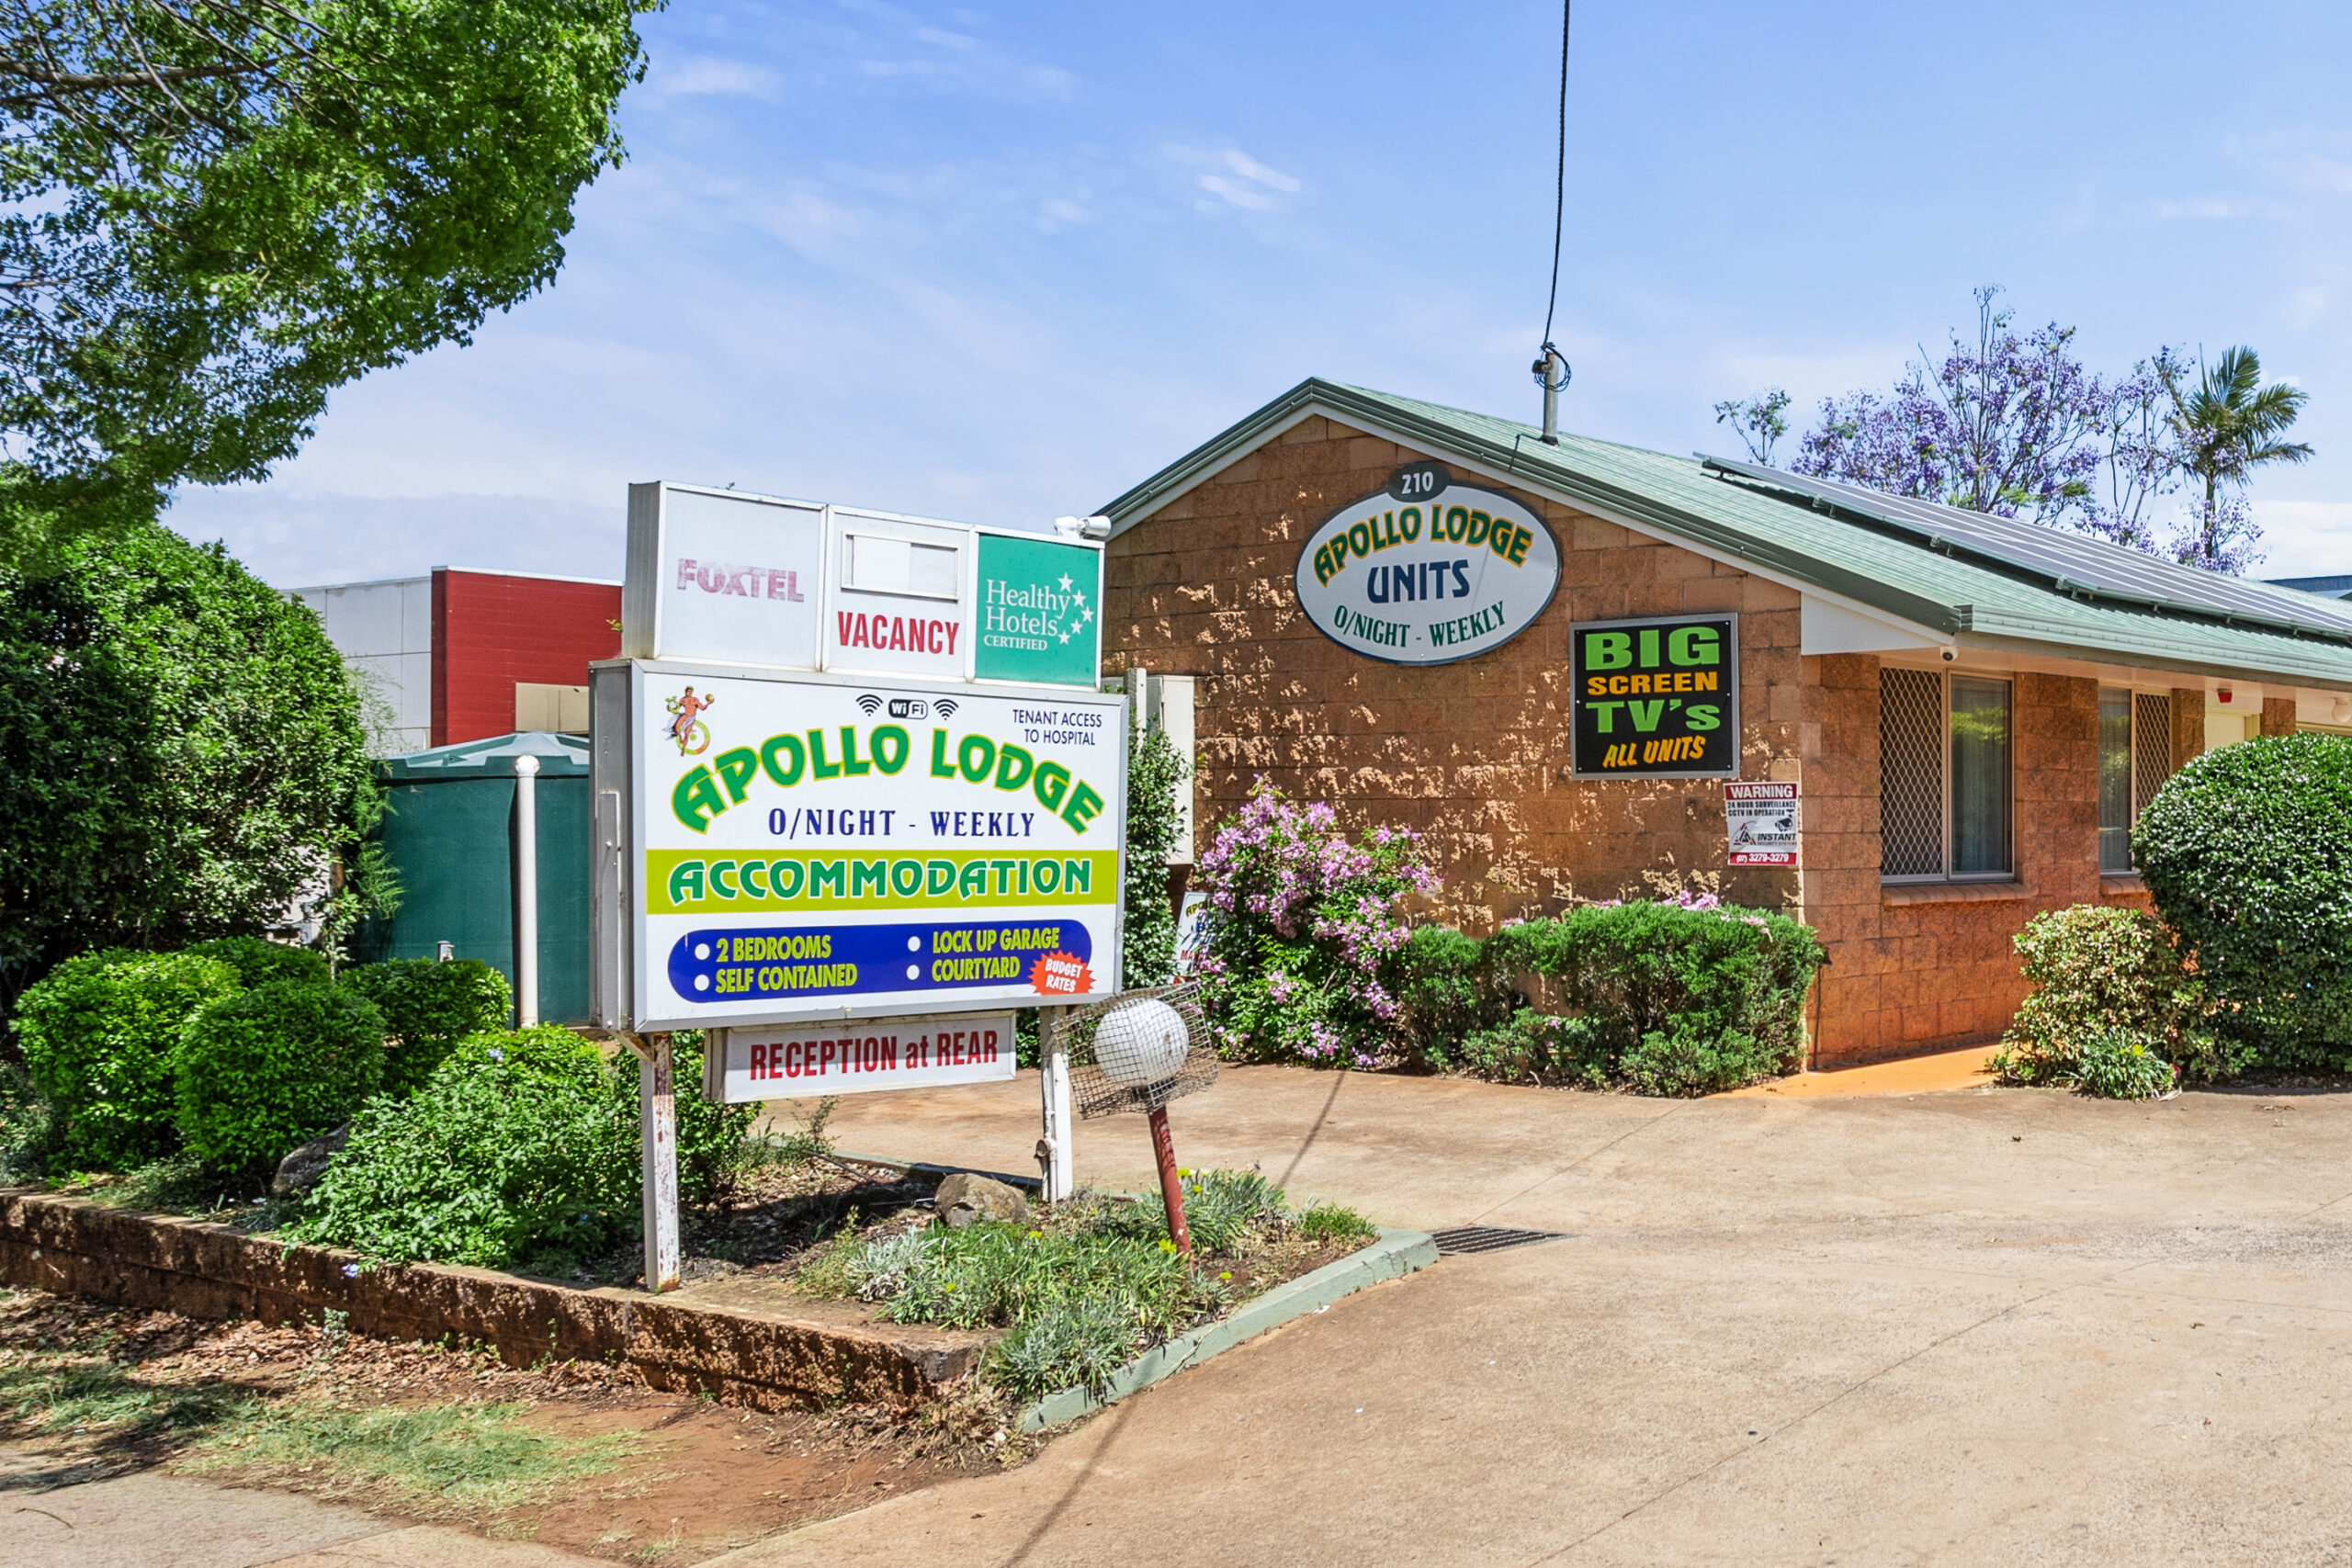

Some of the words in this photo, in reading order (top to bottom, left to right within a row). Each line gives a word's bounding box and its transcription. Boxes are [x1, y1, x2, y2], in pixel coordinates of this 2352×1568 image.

[1401, 471, 1433, 494] 210
[1314, 506, 1422, 587] APOLLO
[1430, 504, 1533, 568] LODGE
[677, 558, 804, 602] FOXTEL
[1367, 559, 1470, 604] UNITS
[986, 579, 1070, 619] Healthy
[838, 611, 959, 654] VACANCY
[985, 605, 1057, 637] Hotels
[1429, 601, 1506, 648] WEEKLY
[983, 634, 1047, 651] CERTIFIED
[1585, 626, 1720, 671] BIG
[1587, 671, 1718, 695] SCREEN
[1013, 709, 1058, 727] TENANT
[1061, 713, 1102, 728] ACCESS
[1024, 728, 1040, 743] TO
[1044, 730, 1095, 746] HOSPITAL
[1602, 742, 1638, 768] ALL
[1643, 735, 1706, 764] UNITS
[671, 724, 910, 834] APOLLO
[930, 728, 1104, 834] LODGE
[1730, 784, 1793, 798] WARNING
[1754, 808, 1785, 817] OPERATION
[1755, 800, 1796, 808] SURVEILLANCE
[930, 810, 1035, 837] WEEKLY
[1757, 832, 1797, 841] INSTANT
[668, 858, 1091, 906] ACCOMMODATION
[716, 938, 729, 963] 2
[732, 935, 831, 963] BEDROOMS
[933, 931, 973, 953] LOCK
[976, 930, 997, 953] UP
[1000, 928, 1059, 951] GARAGE
[715, 968, 754, 994] SELF
[758, 964, 858, 991] CONTAINED
[932, 956, 1021, 982] COURTYARD
[1045, 958, 1083, 979] BUDGET
[1046, 974, 1076, 993] RATES
[750, 1035, 898, 1081] RECEPTION
[906, 1035, 928, 1069] at
[937, 1030, 998, 1066] REAR
